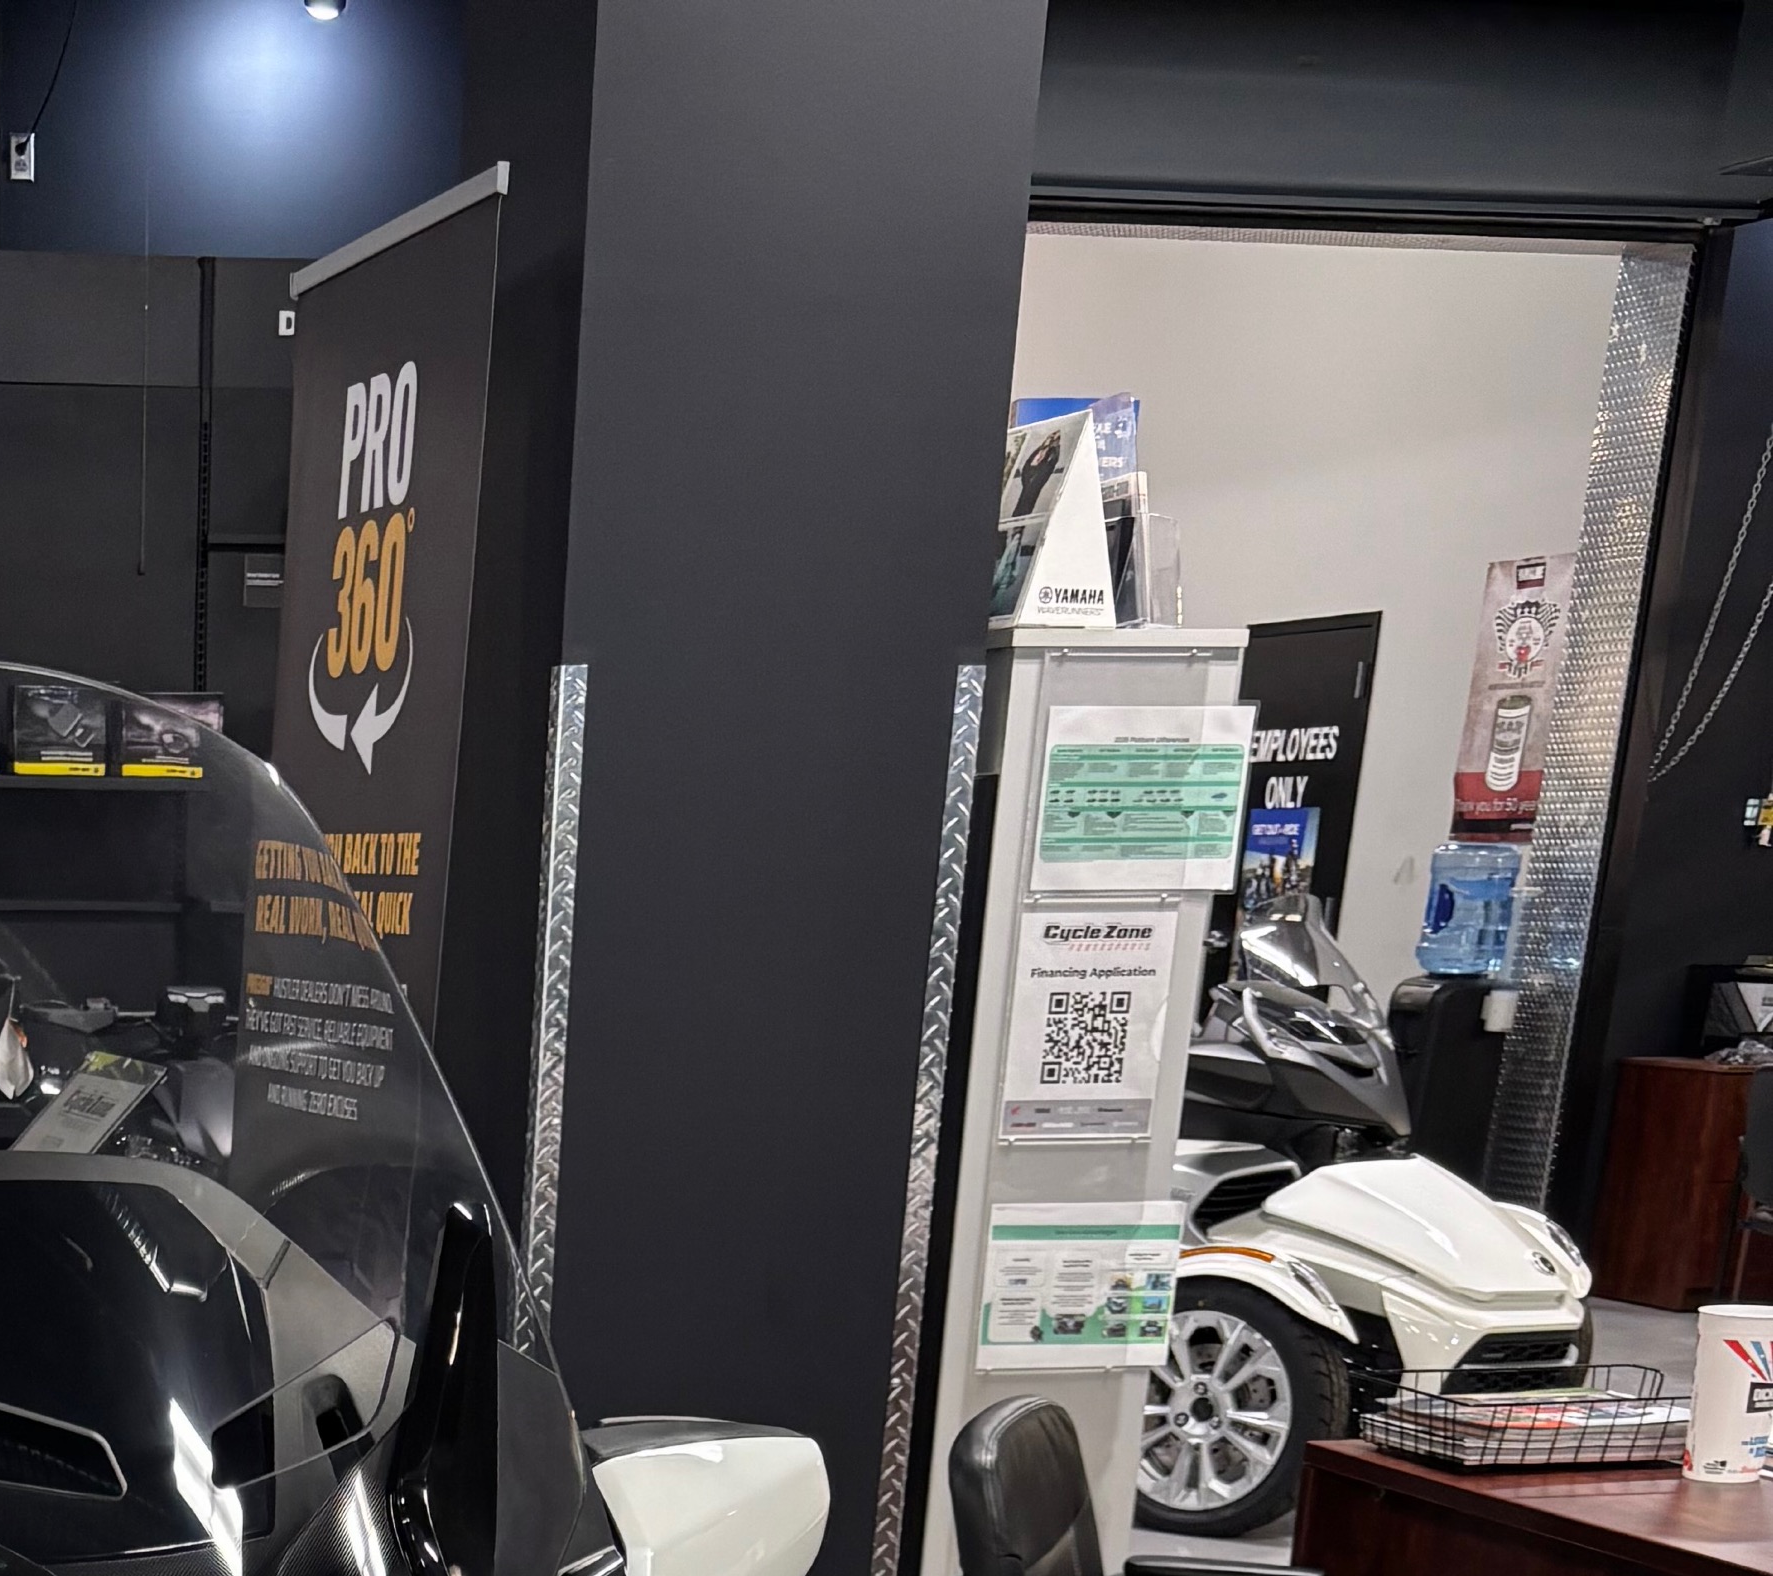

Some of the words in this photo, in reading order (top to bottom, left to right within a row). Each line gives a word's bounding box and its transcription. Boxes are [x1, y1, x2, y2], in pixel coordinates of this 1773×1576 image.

[338, 361, 418, 520] PRO
[1055, 588, 1104, 604] YAMAHA
[1251, 726, 1340, 763] EMPLOYEES
[1264, 775, 1308, 809] ONLY
[343, 833, 377, 874] BACK
[379, 833, 395, 875] TO
[396, 833, 421, 875] THE
[376, 891, 414, 940] QUICK
[1042, 925, 1102, 942] Cycle
[1103, 925, 1153, 939] Zone
[1031, 967, 1087, 980] Financing
[1089, 966, 1156, 979] Application
